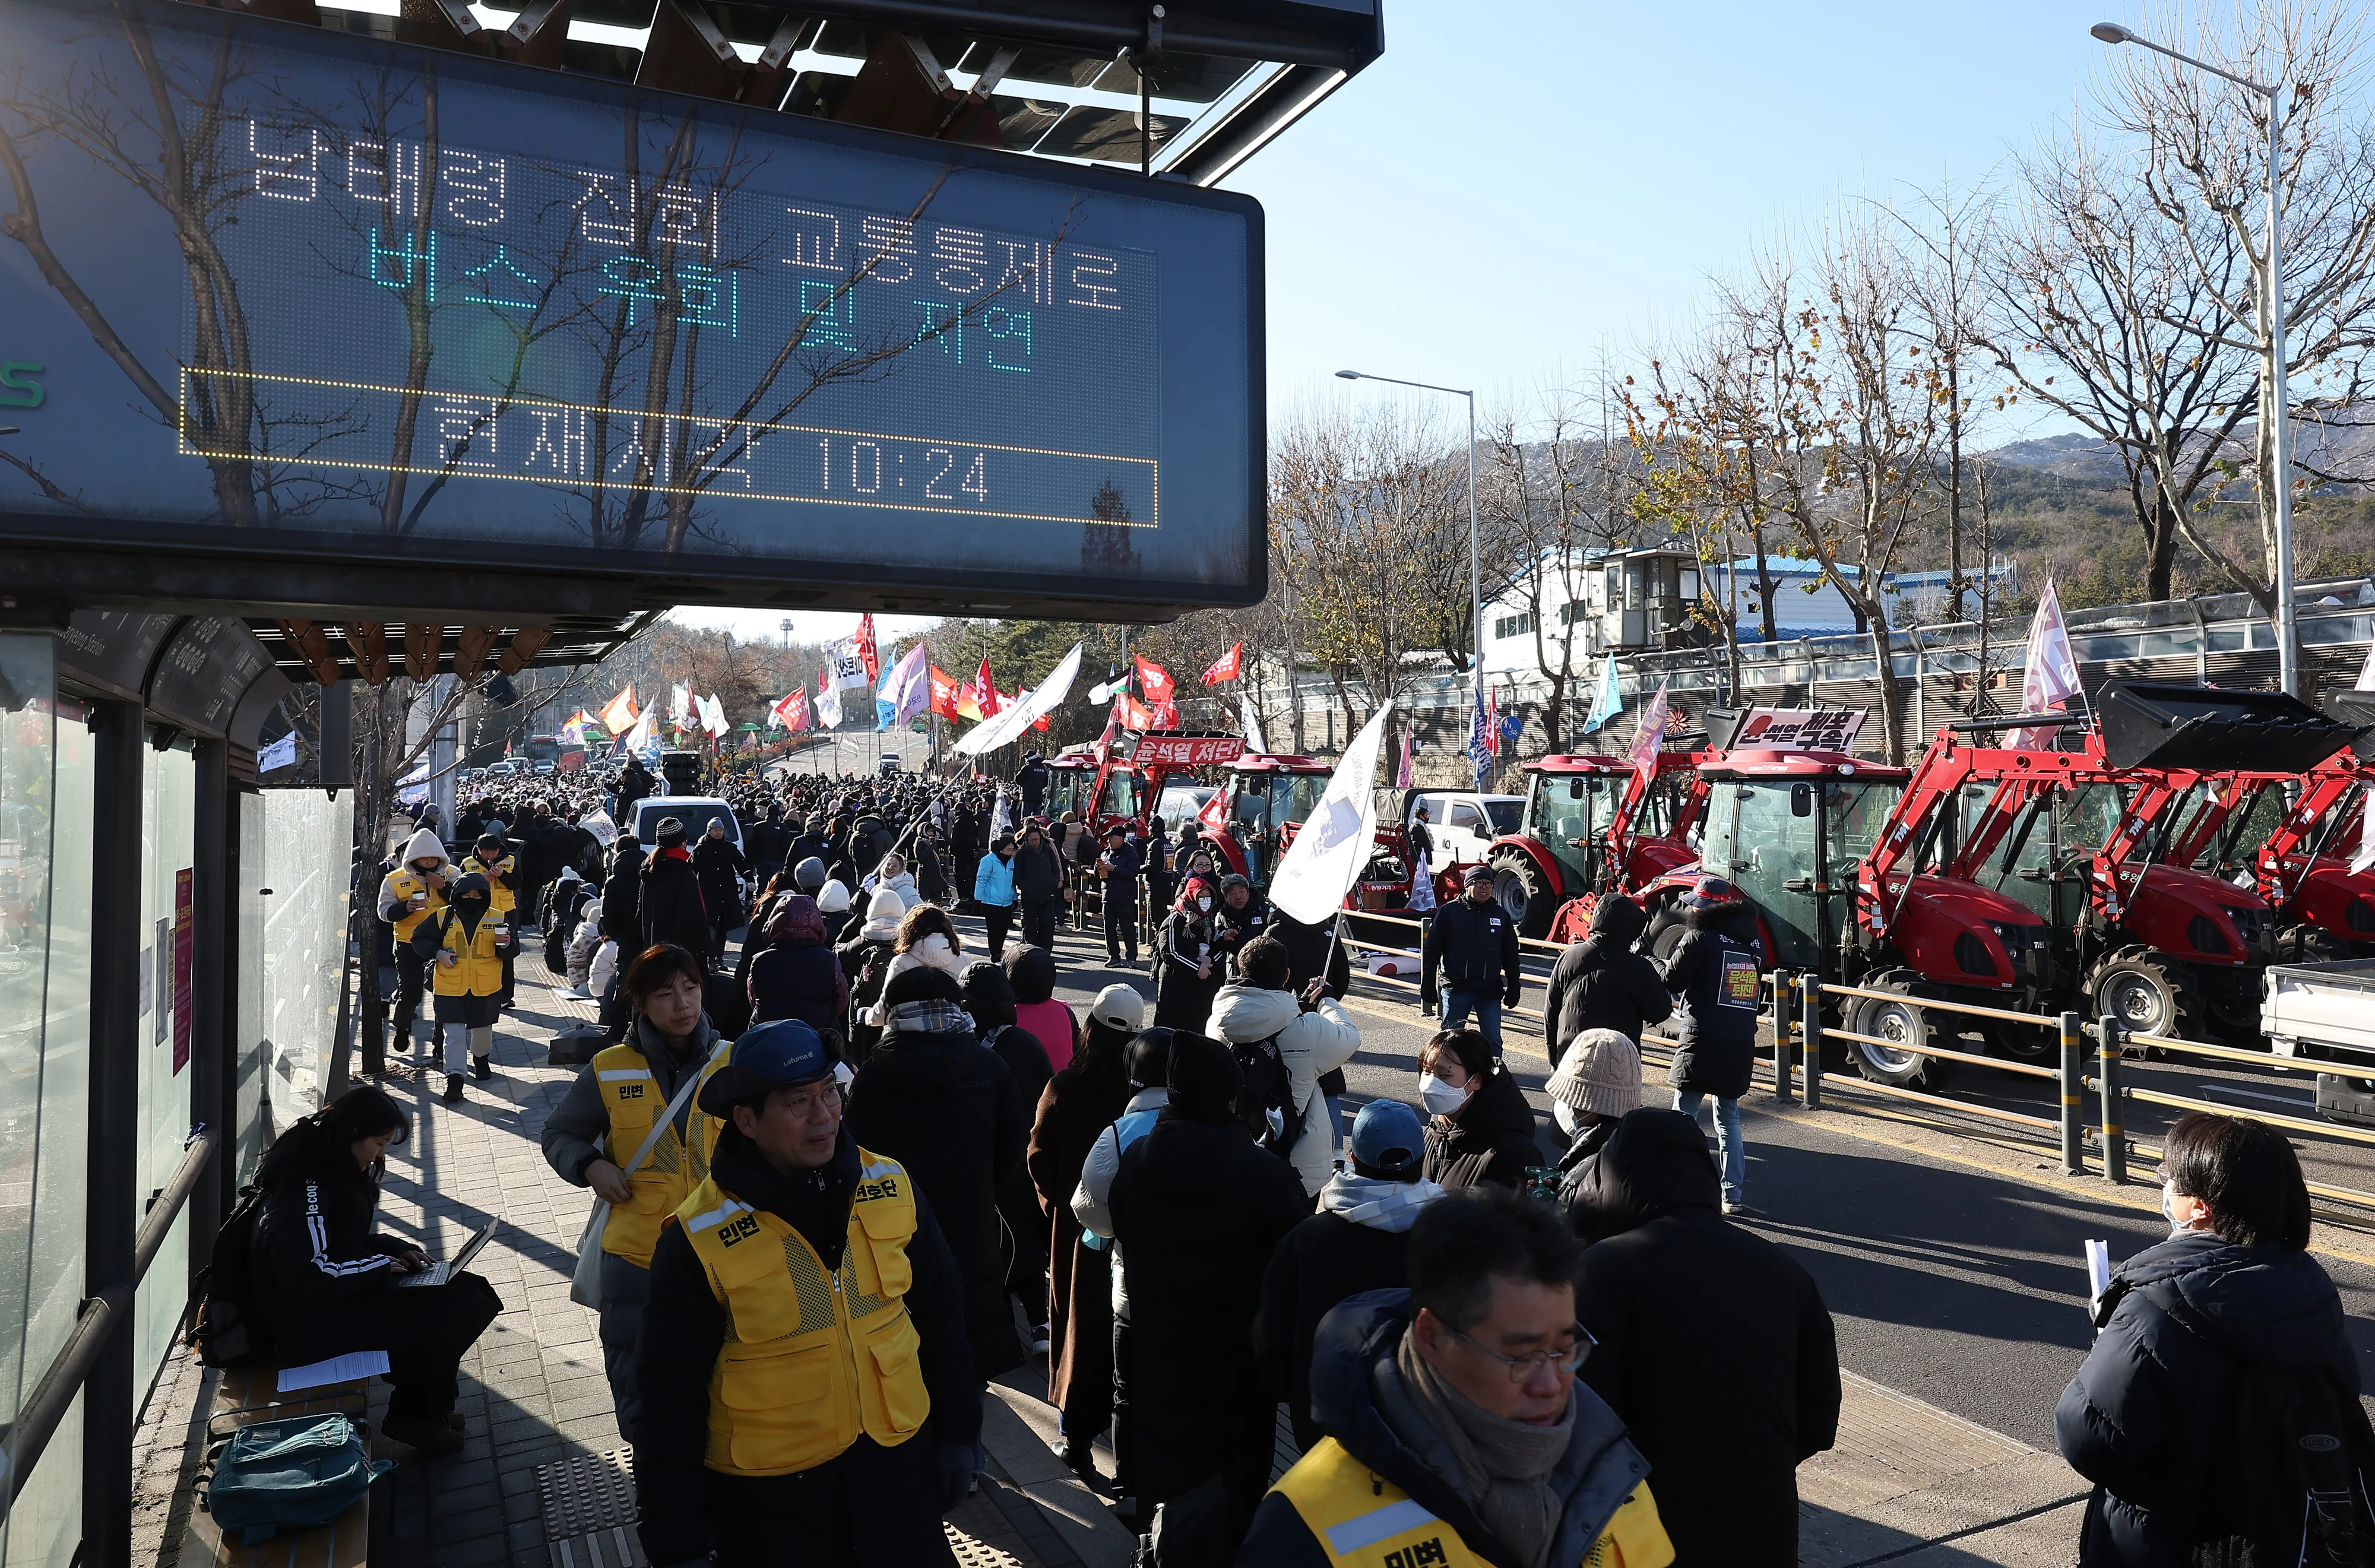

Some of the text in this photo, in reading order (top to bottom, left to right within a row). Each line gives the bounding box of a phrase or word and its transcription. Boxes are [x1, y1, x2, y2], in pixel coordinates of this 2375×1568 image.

[249, 119, 1122, 311] 남태령 집회 교통통제로
[370, 227, 1032, 373] 버스 우회 및 지연
[819, 437, 989, 502] 10:24
[84, 633, 105, 657] Station
[1800, 711, 1855, 731] 체포
[1796, 730, 1854, 752] 구속!
[1135, 740, 1243, 763] 윤석열 처단!
[2299, 807, 2315, 825] TYM
[1894, 825, 1908, 843] TYM
[2129, 818, 2145, 836] TYM
[1728, 970, 1758, 984] 윤석열
[1731, 984, 1755, 997] 퇴진!
[783, 1054, 808, 1066] Lafuma
[619, 1084, 644, 1100] 민변
[306, 1185, 318, 1203] coq
[717, 1214, 761, 1248] 민변
